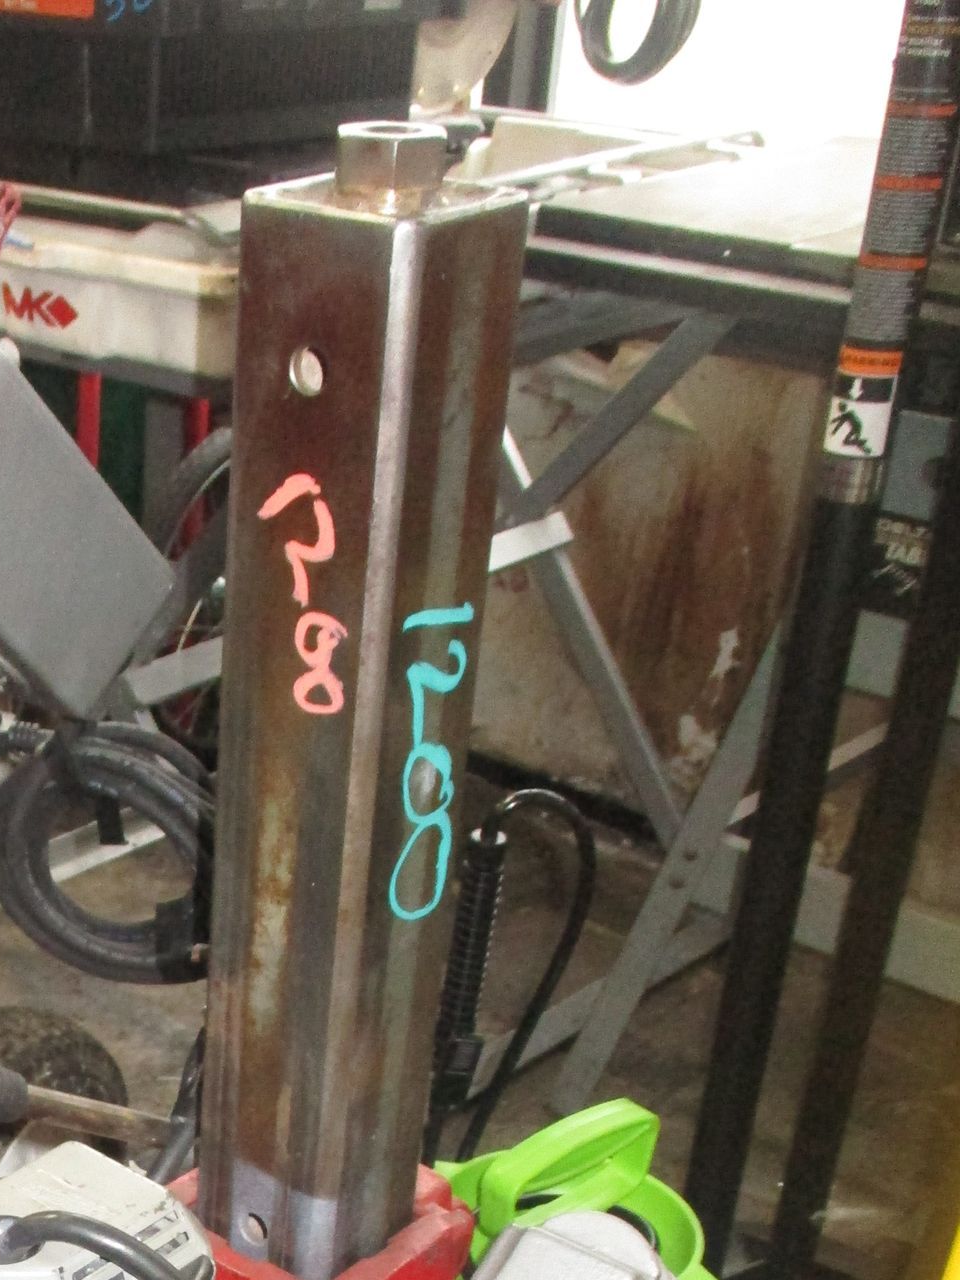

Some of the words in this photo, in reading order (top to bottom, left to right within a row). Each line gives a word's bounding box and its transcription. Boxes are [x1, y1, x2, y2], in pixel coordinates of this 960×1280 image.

[2, 281, 53, 326] MK
[257, 473, 347, 715] 1200
[389, 601, 474, 920] 1200
